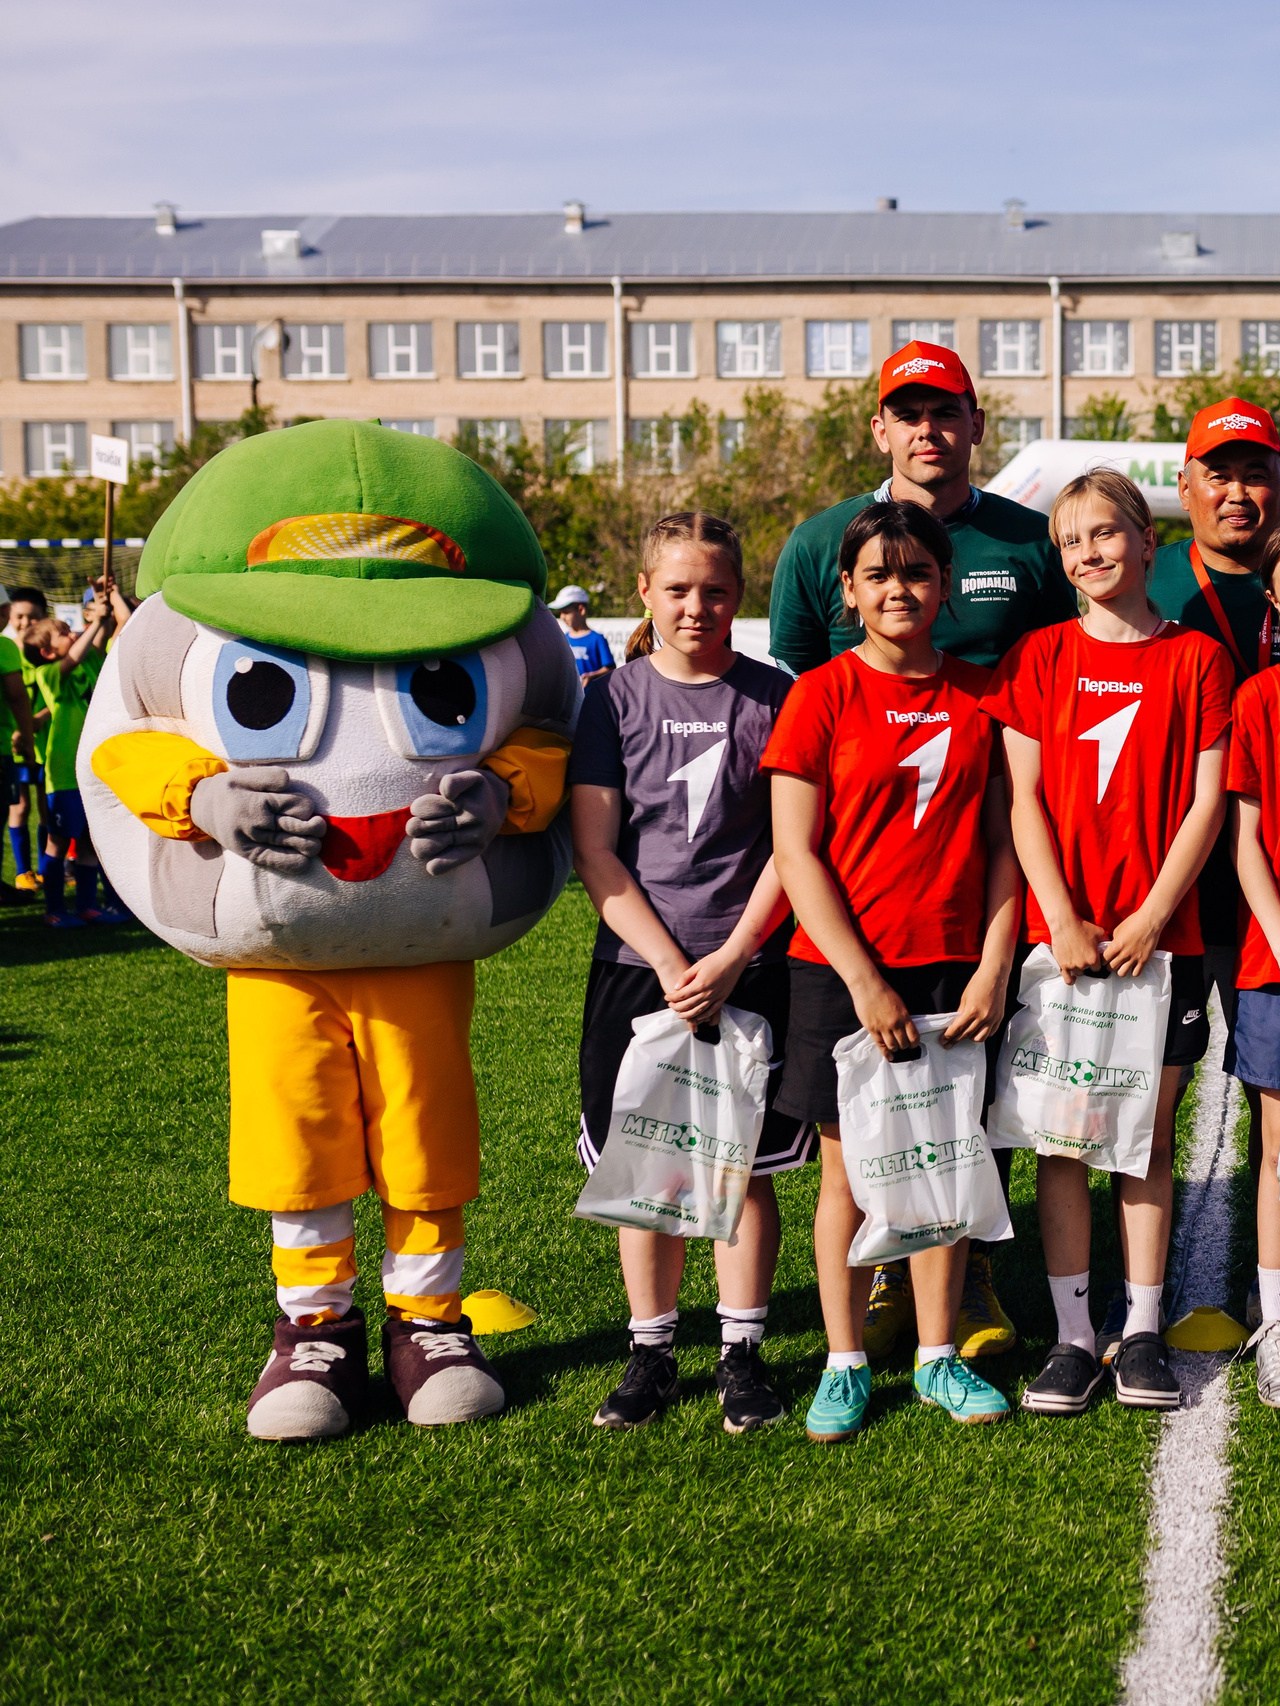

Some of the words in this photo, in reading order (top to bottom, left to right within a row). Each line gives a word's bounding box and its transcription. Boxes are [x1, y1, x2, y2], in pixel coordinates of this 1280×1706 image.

[961, 576, 1017, 595] КОМАНДА
[1078, 678, 1142, 696] Первые
[886, 711, 949, 725] Первые
[663, 720, 727, 737] Первые
[1070, 1006, 1094, 1016] ЖИВИ
[657, 1062, 682, 1074] ИГРАЙ,
[894, 1092, 919, 1102] ЖИВИ
[630, 1200, 699, 1224] METROSHKA.RU
[900, 1220, 968, 1241] METROSHKA.RU
